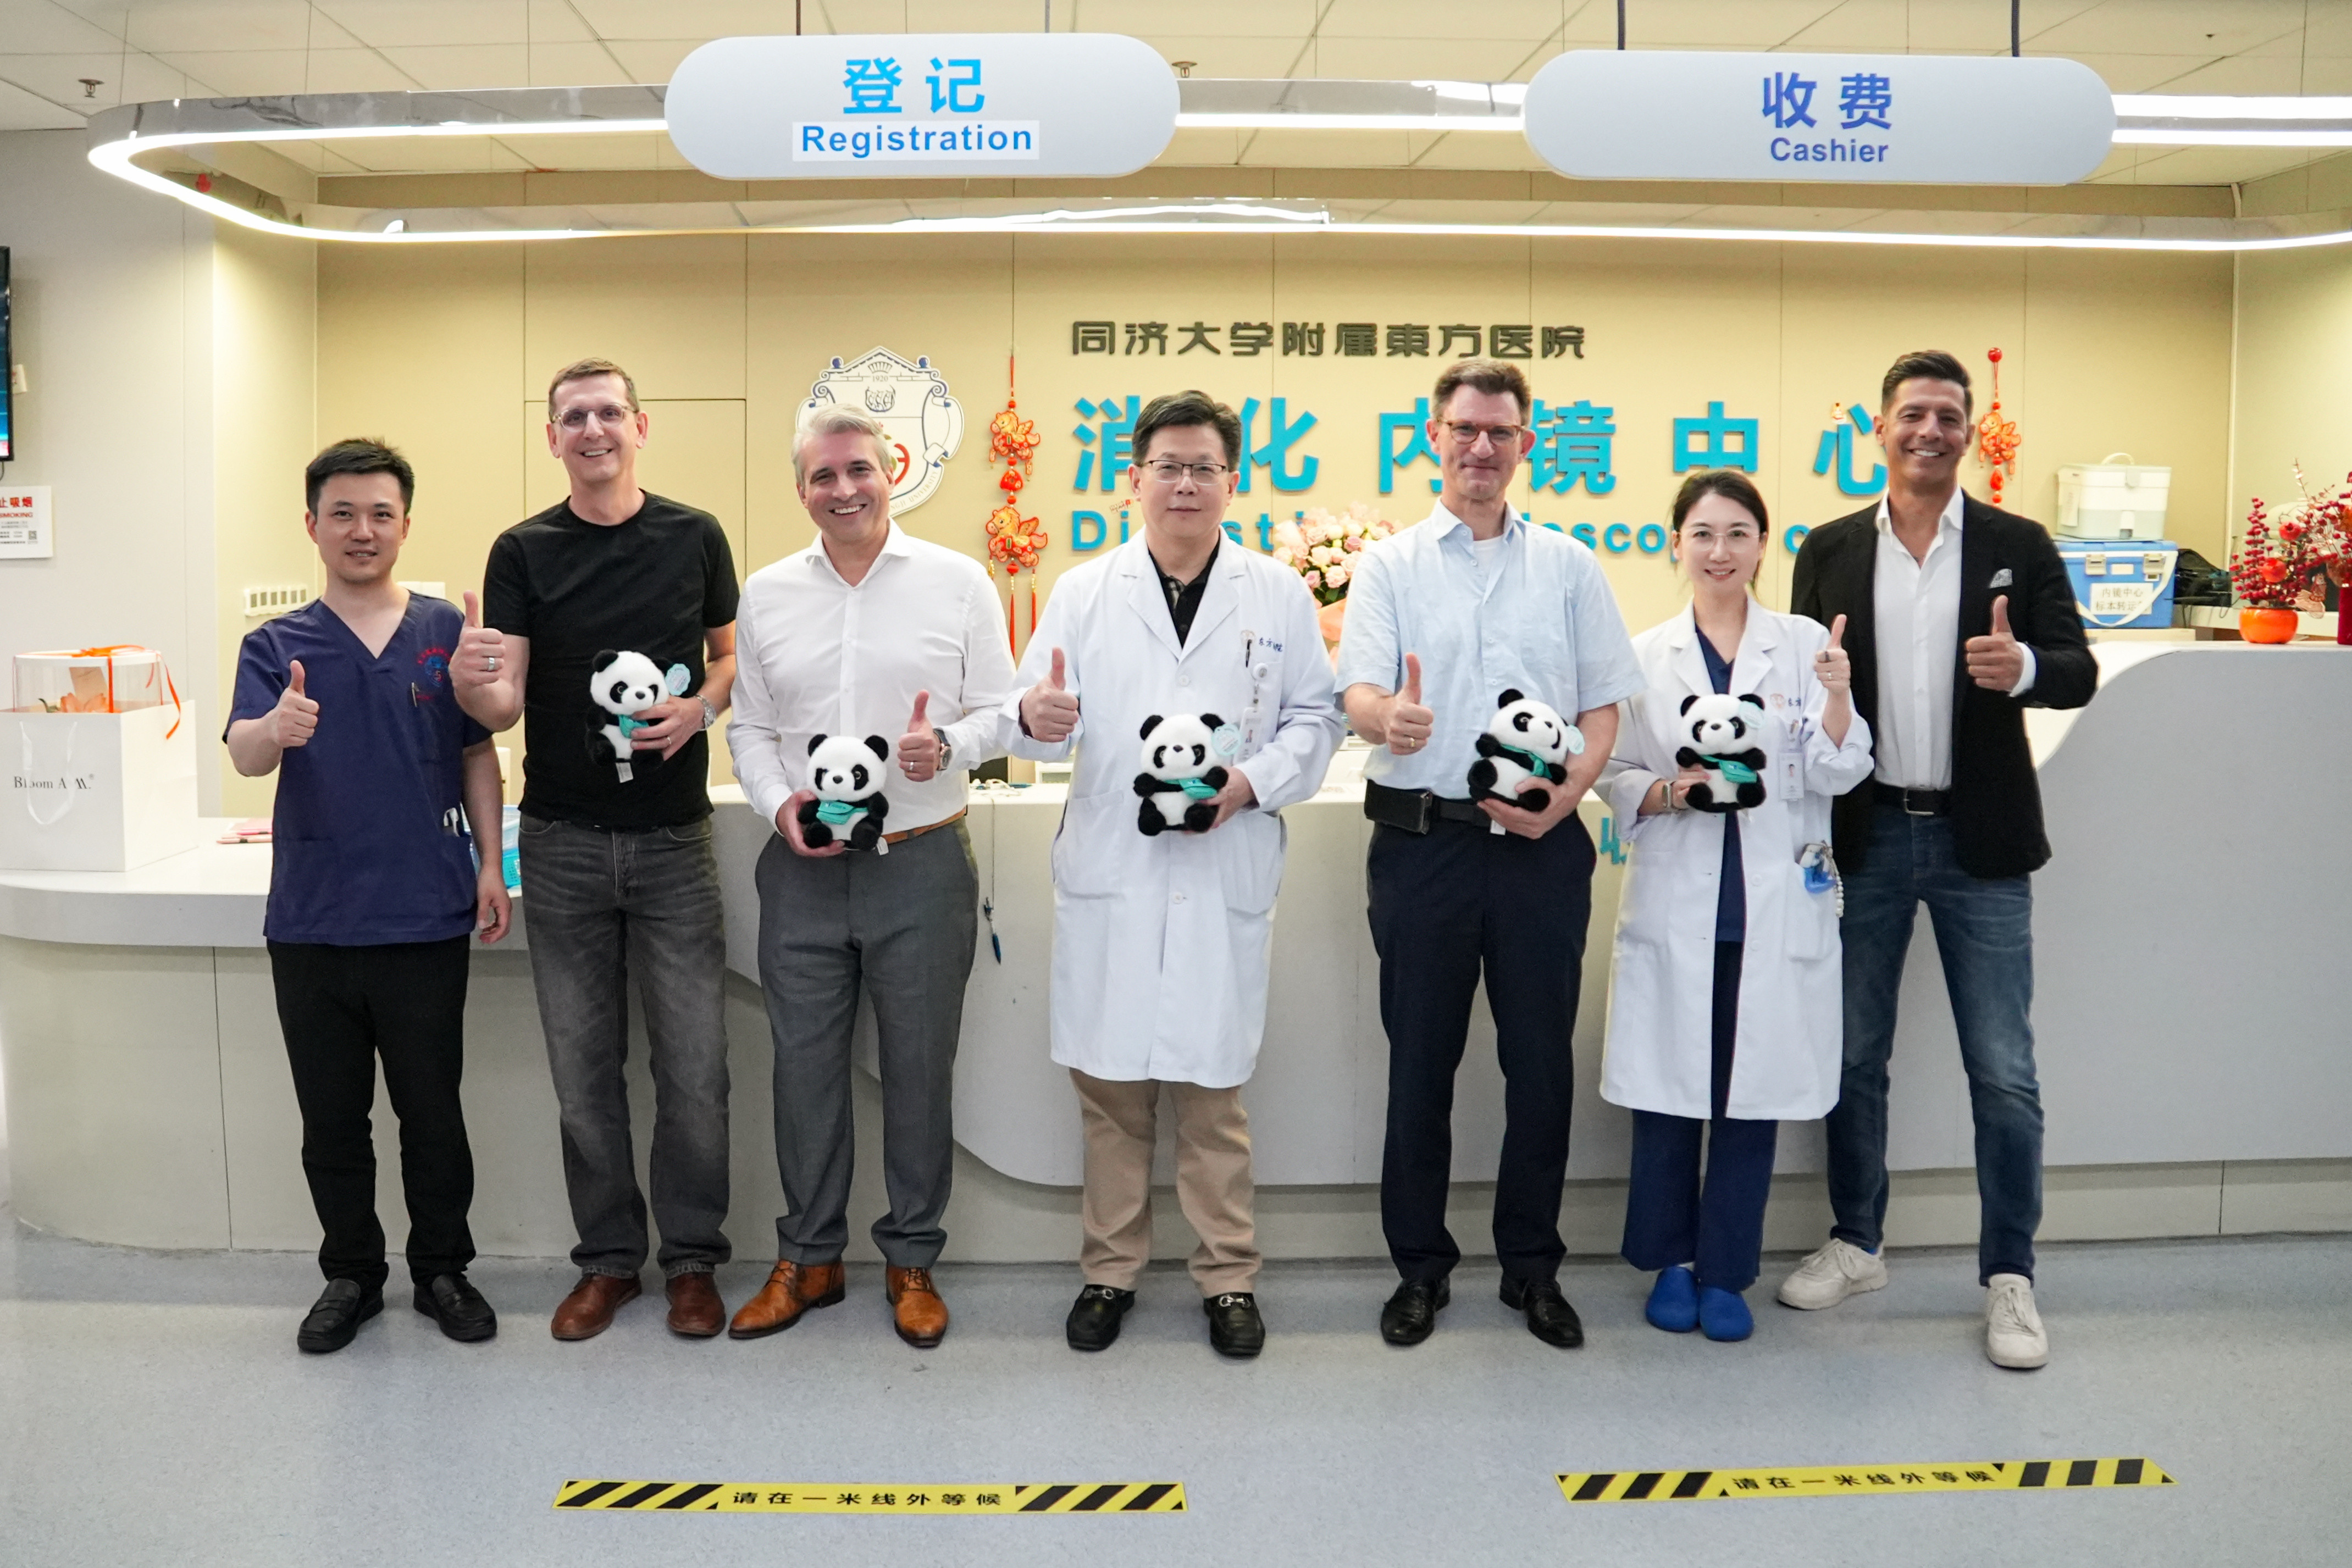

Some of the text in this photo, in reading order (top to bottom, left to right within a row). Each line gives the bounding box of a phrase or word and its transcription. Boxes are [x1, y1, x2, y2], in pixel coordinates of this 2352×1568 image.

[843, 57, 985, 114] 登记
[1762, 72, 1892, 130] 收费
[802, 124, 1032, 158] Registration
[1770, 137, 1889, 162] Cashier
[0, 496, 33, 508] 止吸烟
[2096, 600, 2148, 611] 标本转运
[1732, 1471, 1995, 1490] 请在一米线外等候
[733, 1492, 1001, 1505] 请在一米线外等候
